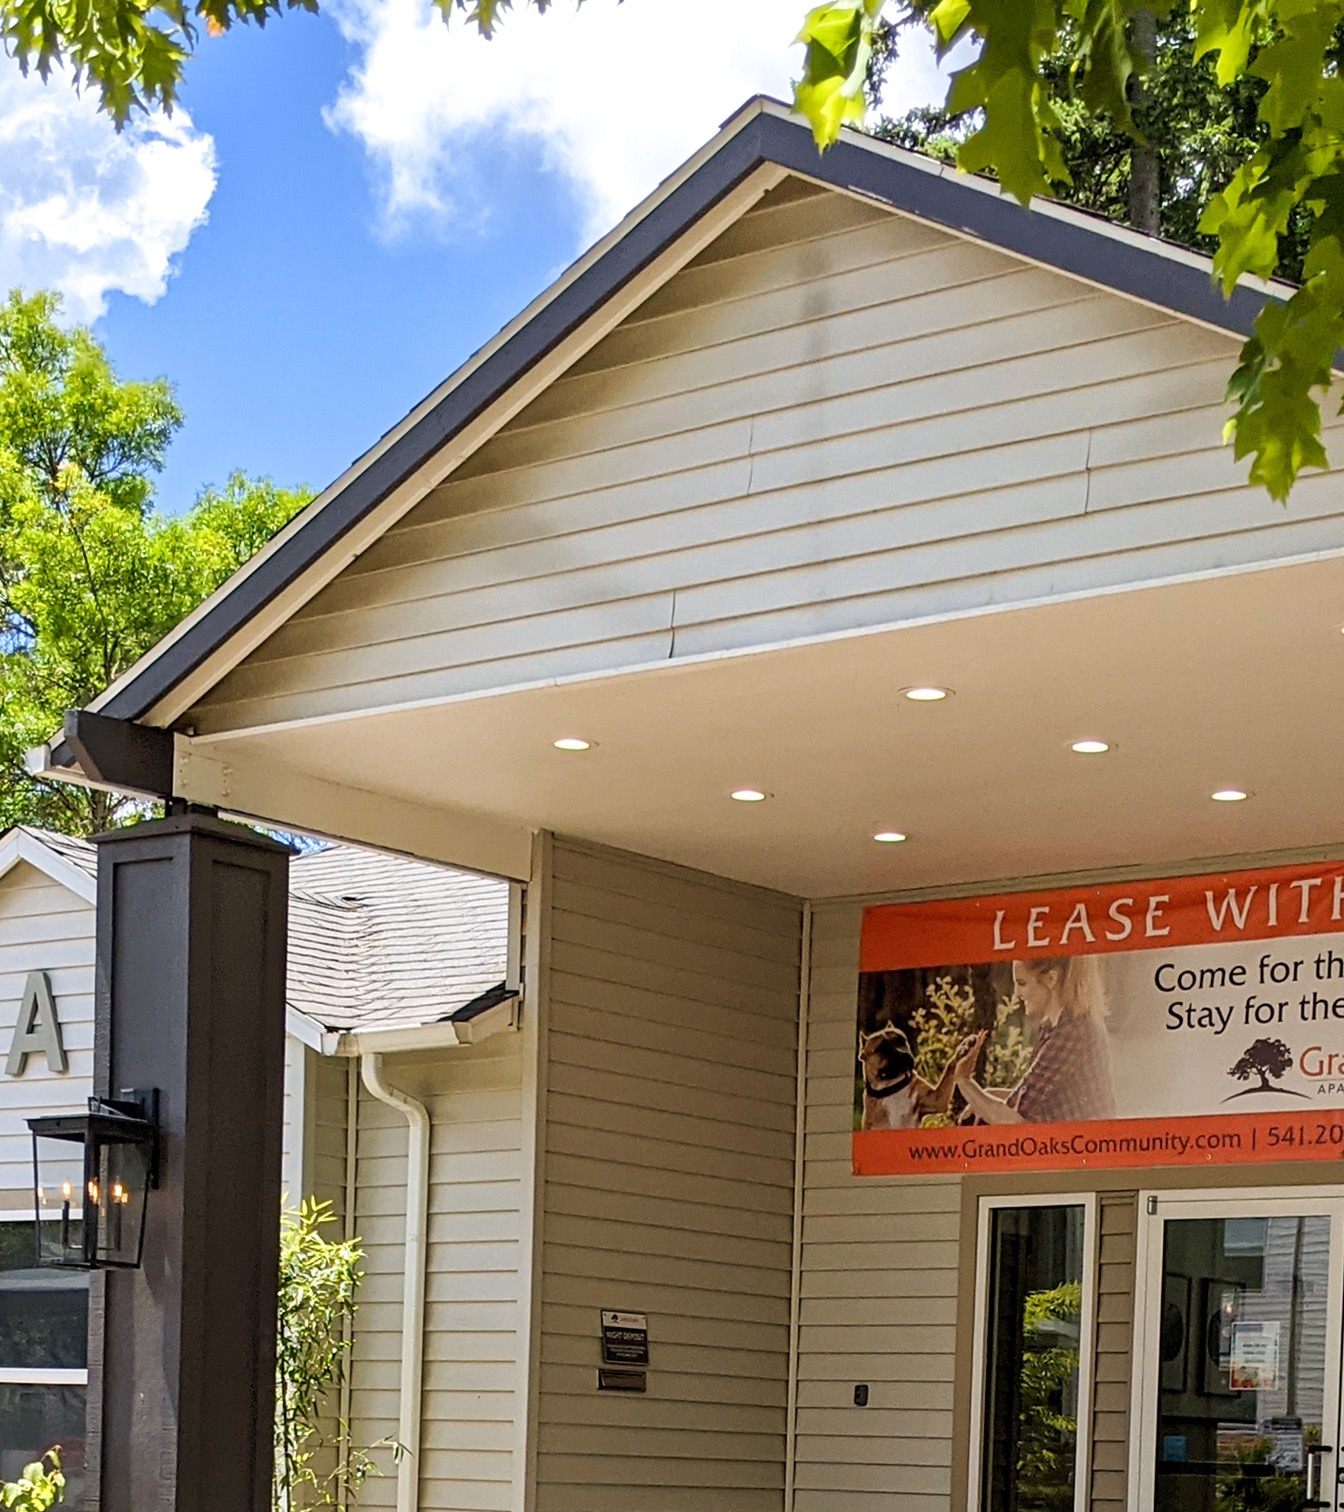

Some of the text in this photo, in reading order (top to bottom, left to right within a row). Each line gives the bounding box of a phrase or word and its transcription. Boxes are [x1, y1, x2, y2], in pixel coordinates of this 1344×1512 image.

[993, 894, 1171, 950] LEASE
[1154, 963, 1247, 992] Come
[1259, 954, 1305, 984] for
[5, 970, 68, 1076] A
[1165, 1001, 1234, 1035] Stay
[1243, 995, 1289, 1025] for
[908, 1130, 1242, 1161] www.GrandOaksCommunity.com
